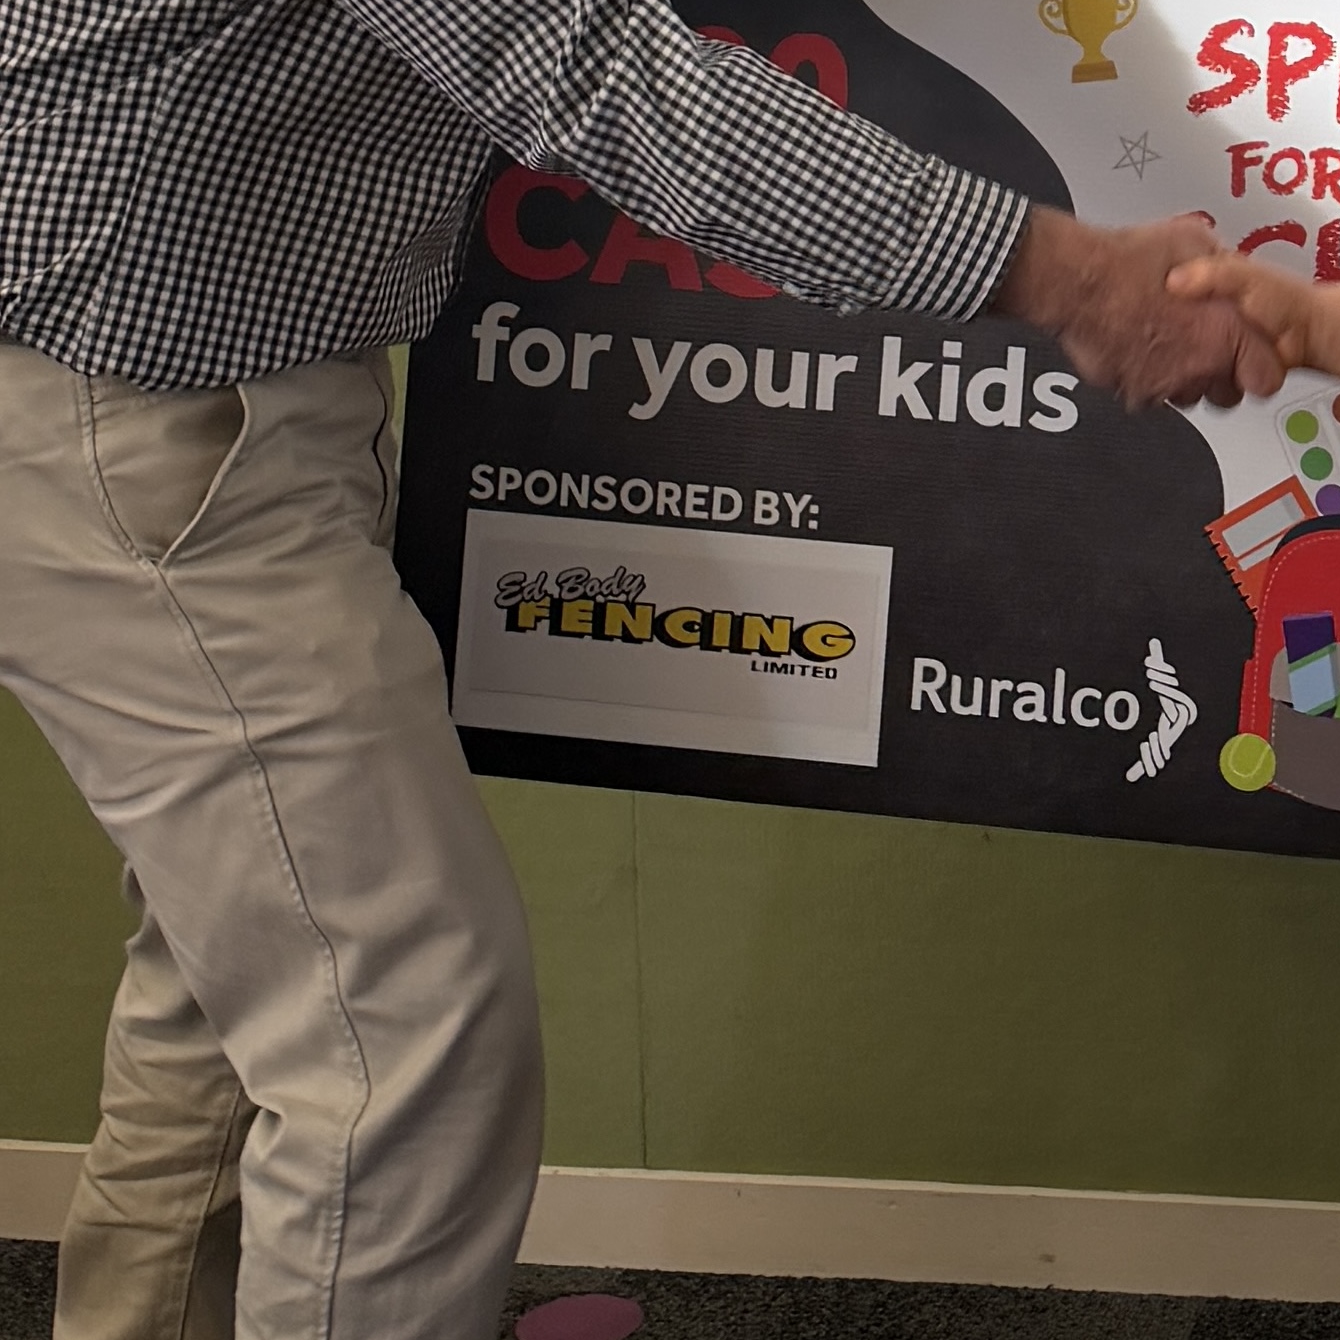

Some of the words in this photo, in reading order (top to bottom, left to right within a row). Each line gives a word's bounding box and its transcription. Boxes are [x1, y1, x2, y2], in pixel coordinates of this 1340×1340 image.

[472, 301, 612, 390] for
[628, 336, 857, 421] your
[877, 336, 1081, 433] kids
[469, 464, 743, 522] SPONSORED
[752, 489, 821, 530] BY:
[495, 571, 549, 609] Ed
[555, 566, 646, 604] Body
[506, 597, 857, 662] FENCING
[751, 660, 838, 680] LIMITED
[909, 656, 1141, 731] Ruralco
